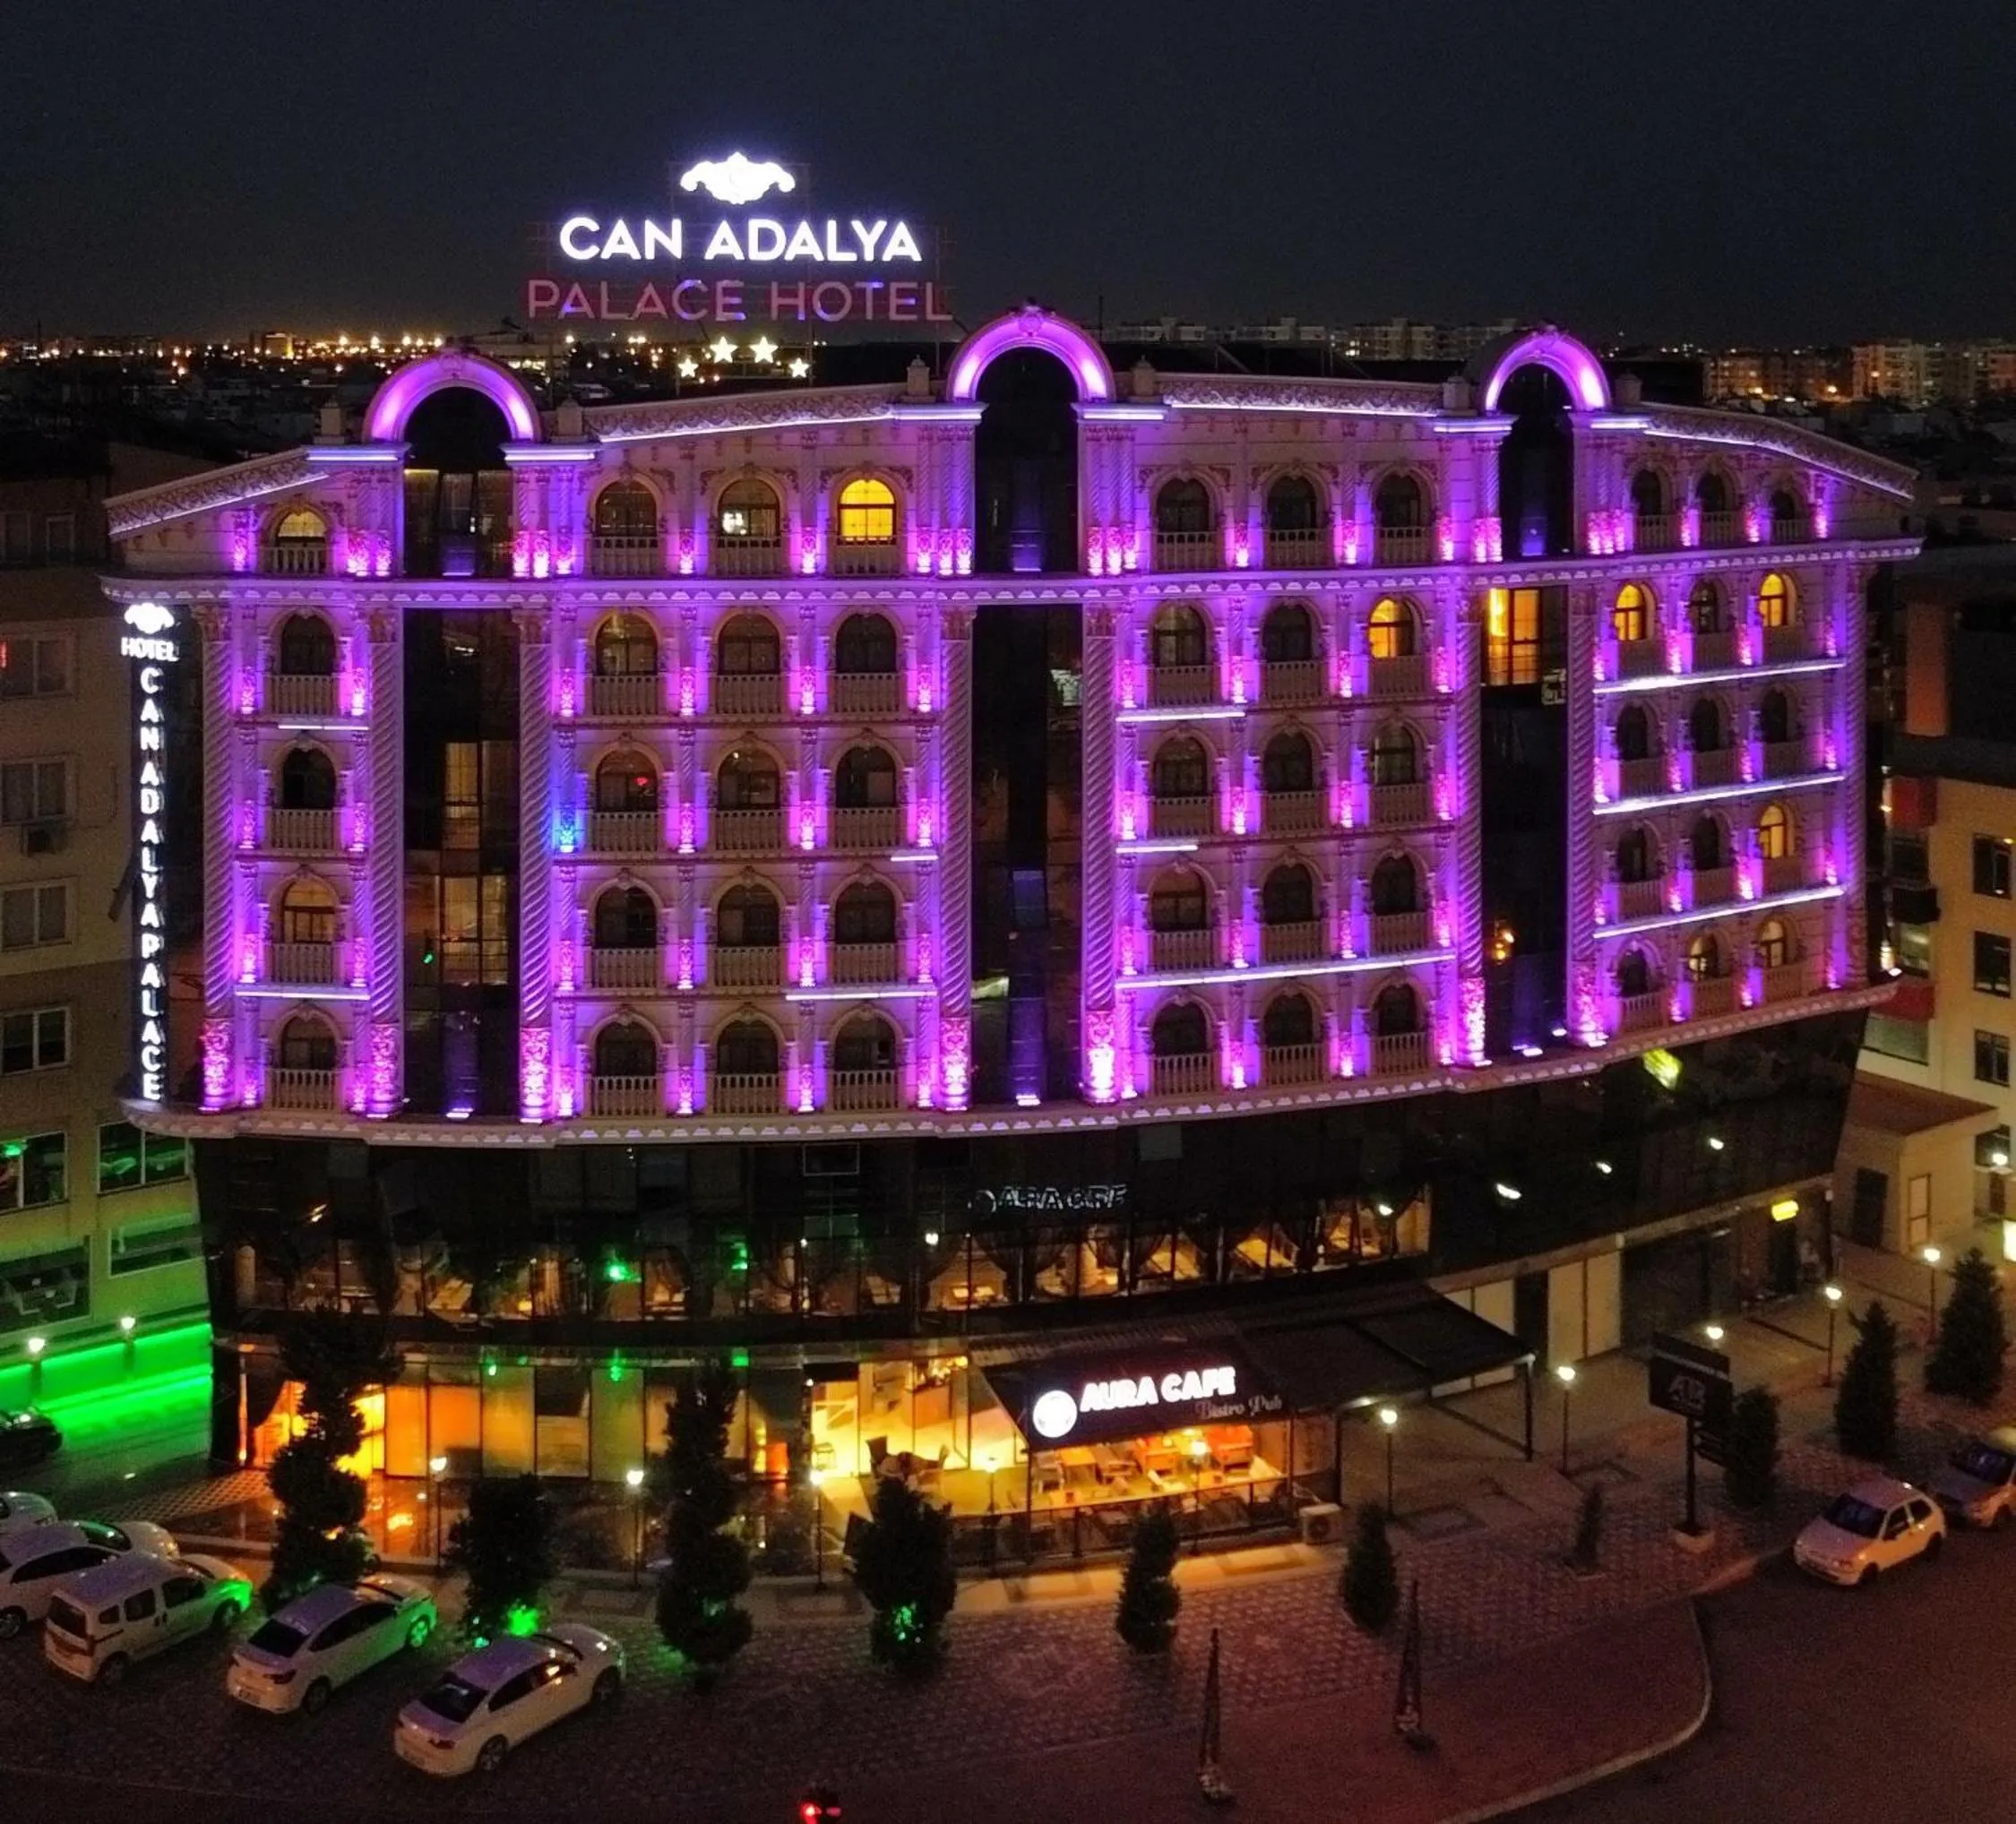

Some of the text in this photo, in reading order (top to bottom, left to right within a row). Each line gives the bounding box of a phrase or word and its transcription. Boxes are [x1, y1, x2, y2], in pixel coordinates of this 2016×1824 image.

[559, 217, 922, 262] CAN ADALYA
[528, 279, 953, 322] PALACE HOTEL
[121, 637, 179, 662] HOTEL
[1079, 1365, 1236, 1413] AURA CAFE
